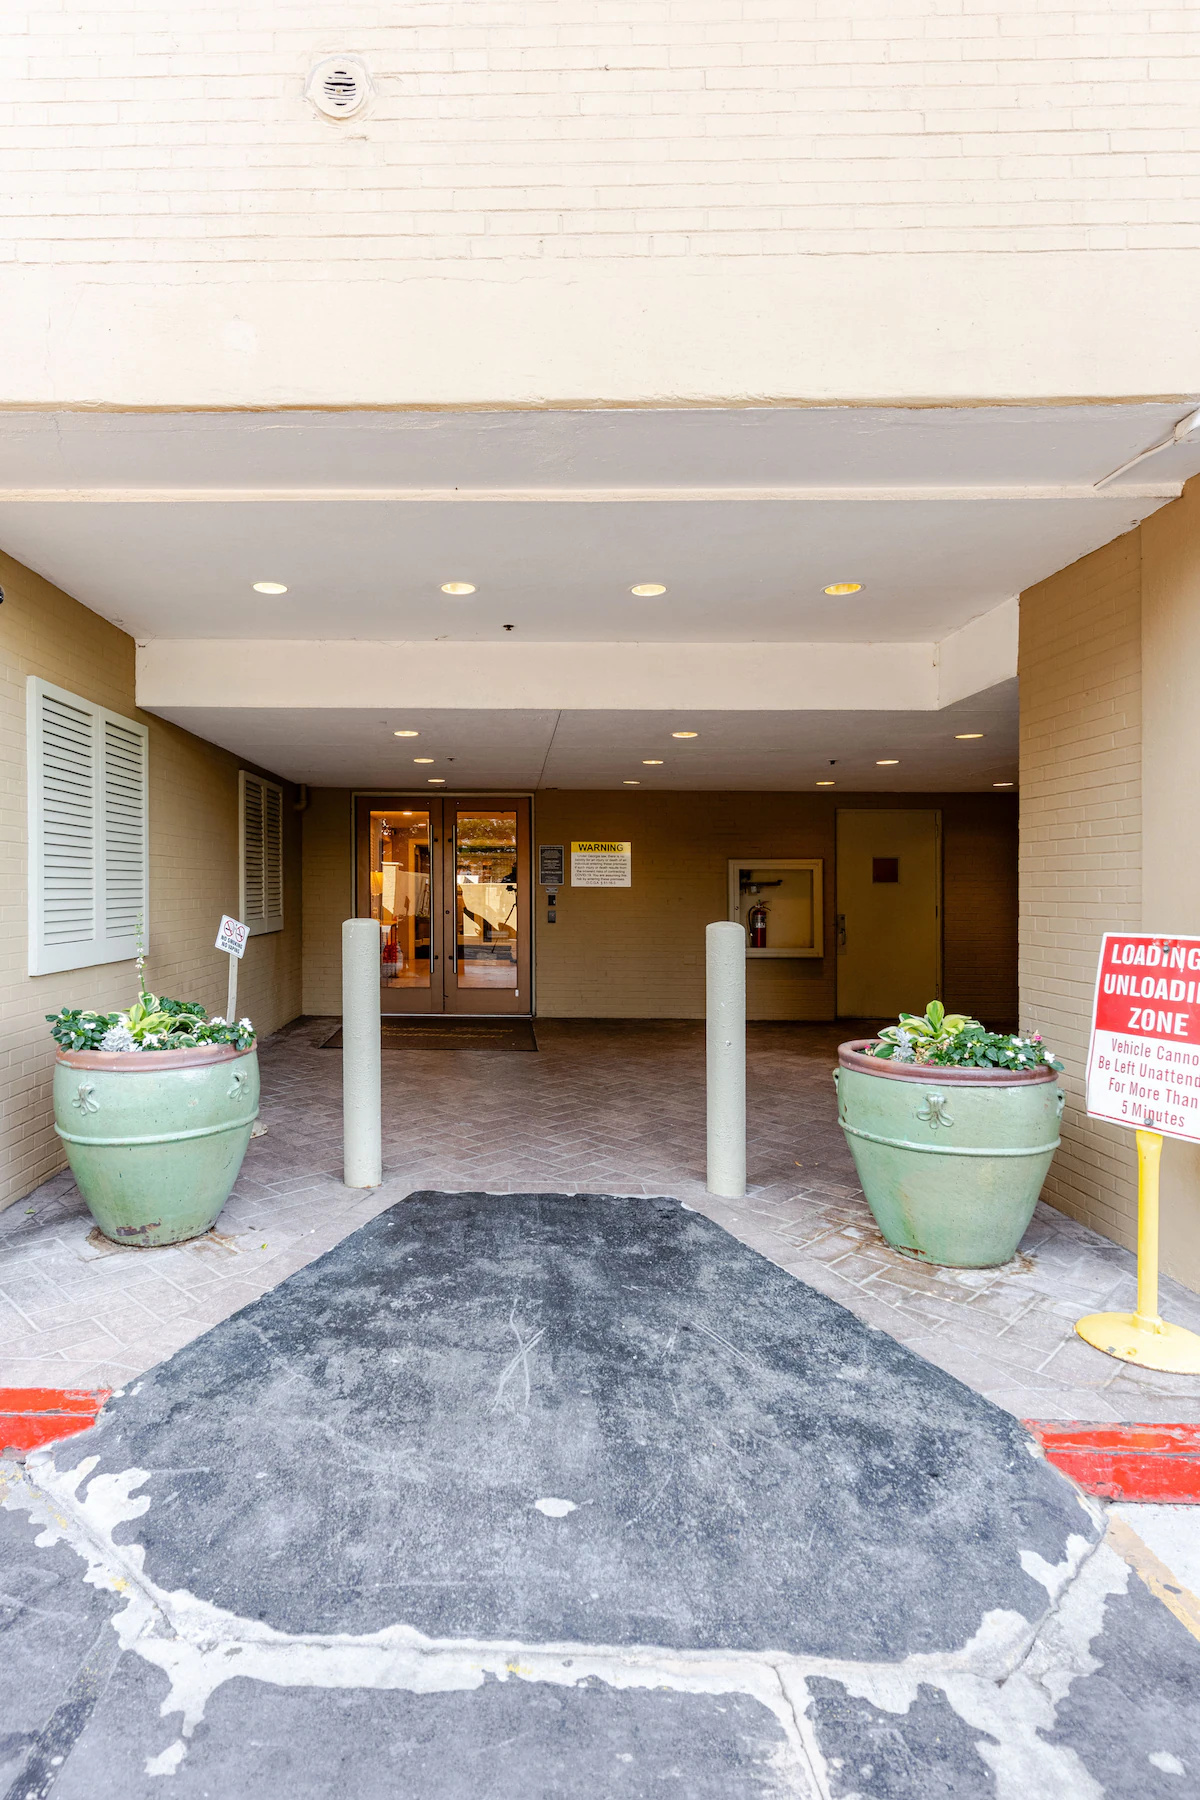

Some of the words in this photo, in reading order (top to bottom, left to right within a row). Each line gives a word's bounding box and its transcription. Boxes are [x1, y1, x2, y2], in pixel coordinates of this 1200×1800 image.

[1111, 944, 1200, 970] LOADING
[1103, 974, 1200, 1004] UNLOADI
[1128, 1007, 1189, 1036] ZONE
[1112, 1038, 1151, 1058] Vehicle
[1098, 1055, 1111, 1070] Be
[1114, 1058, 1135, 1076] Left
[1109, 1077, 1126, 1094] For
[1129, 1081, 1160, 1100] More
[1166, 1088, 1198, 1109] Than
[1122, 1100, 1128, 1114] 5
[1132, 1102, 1185, 1128] Minutes
